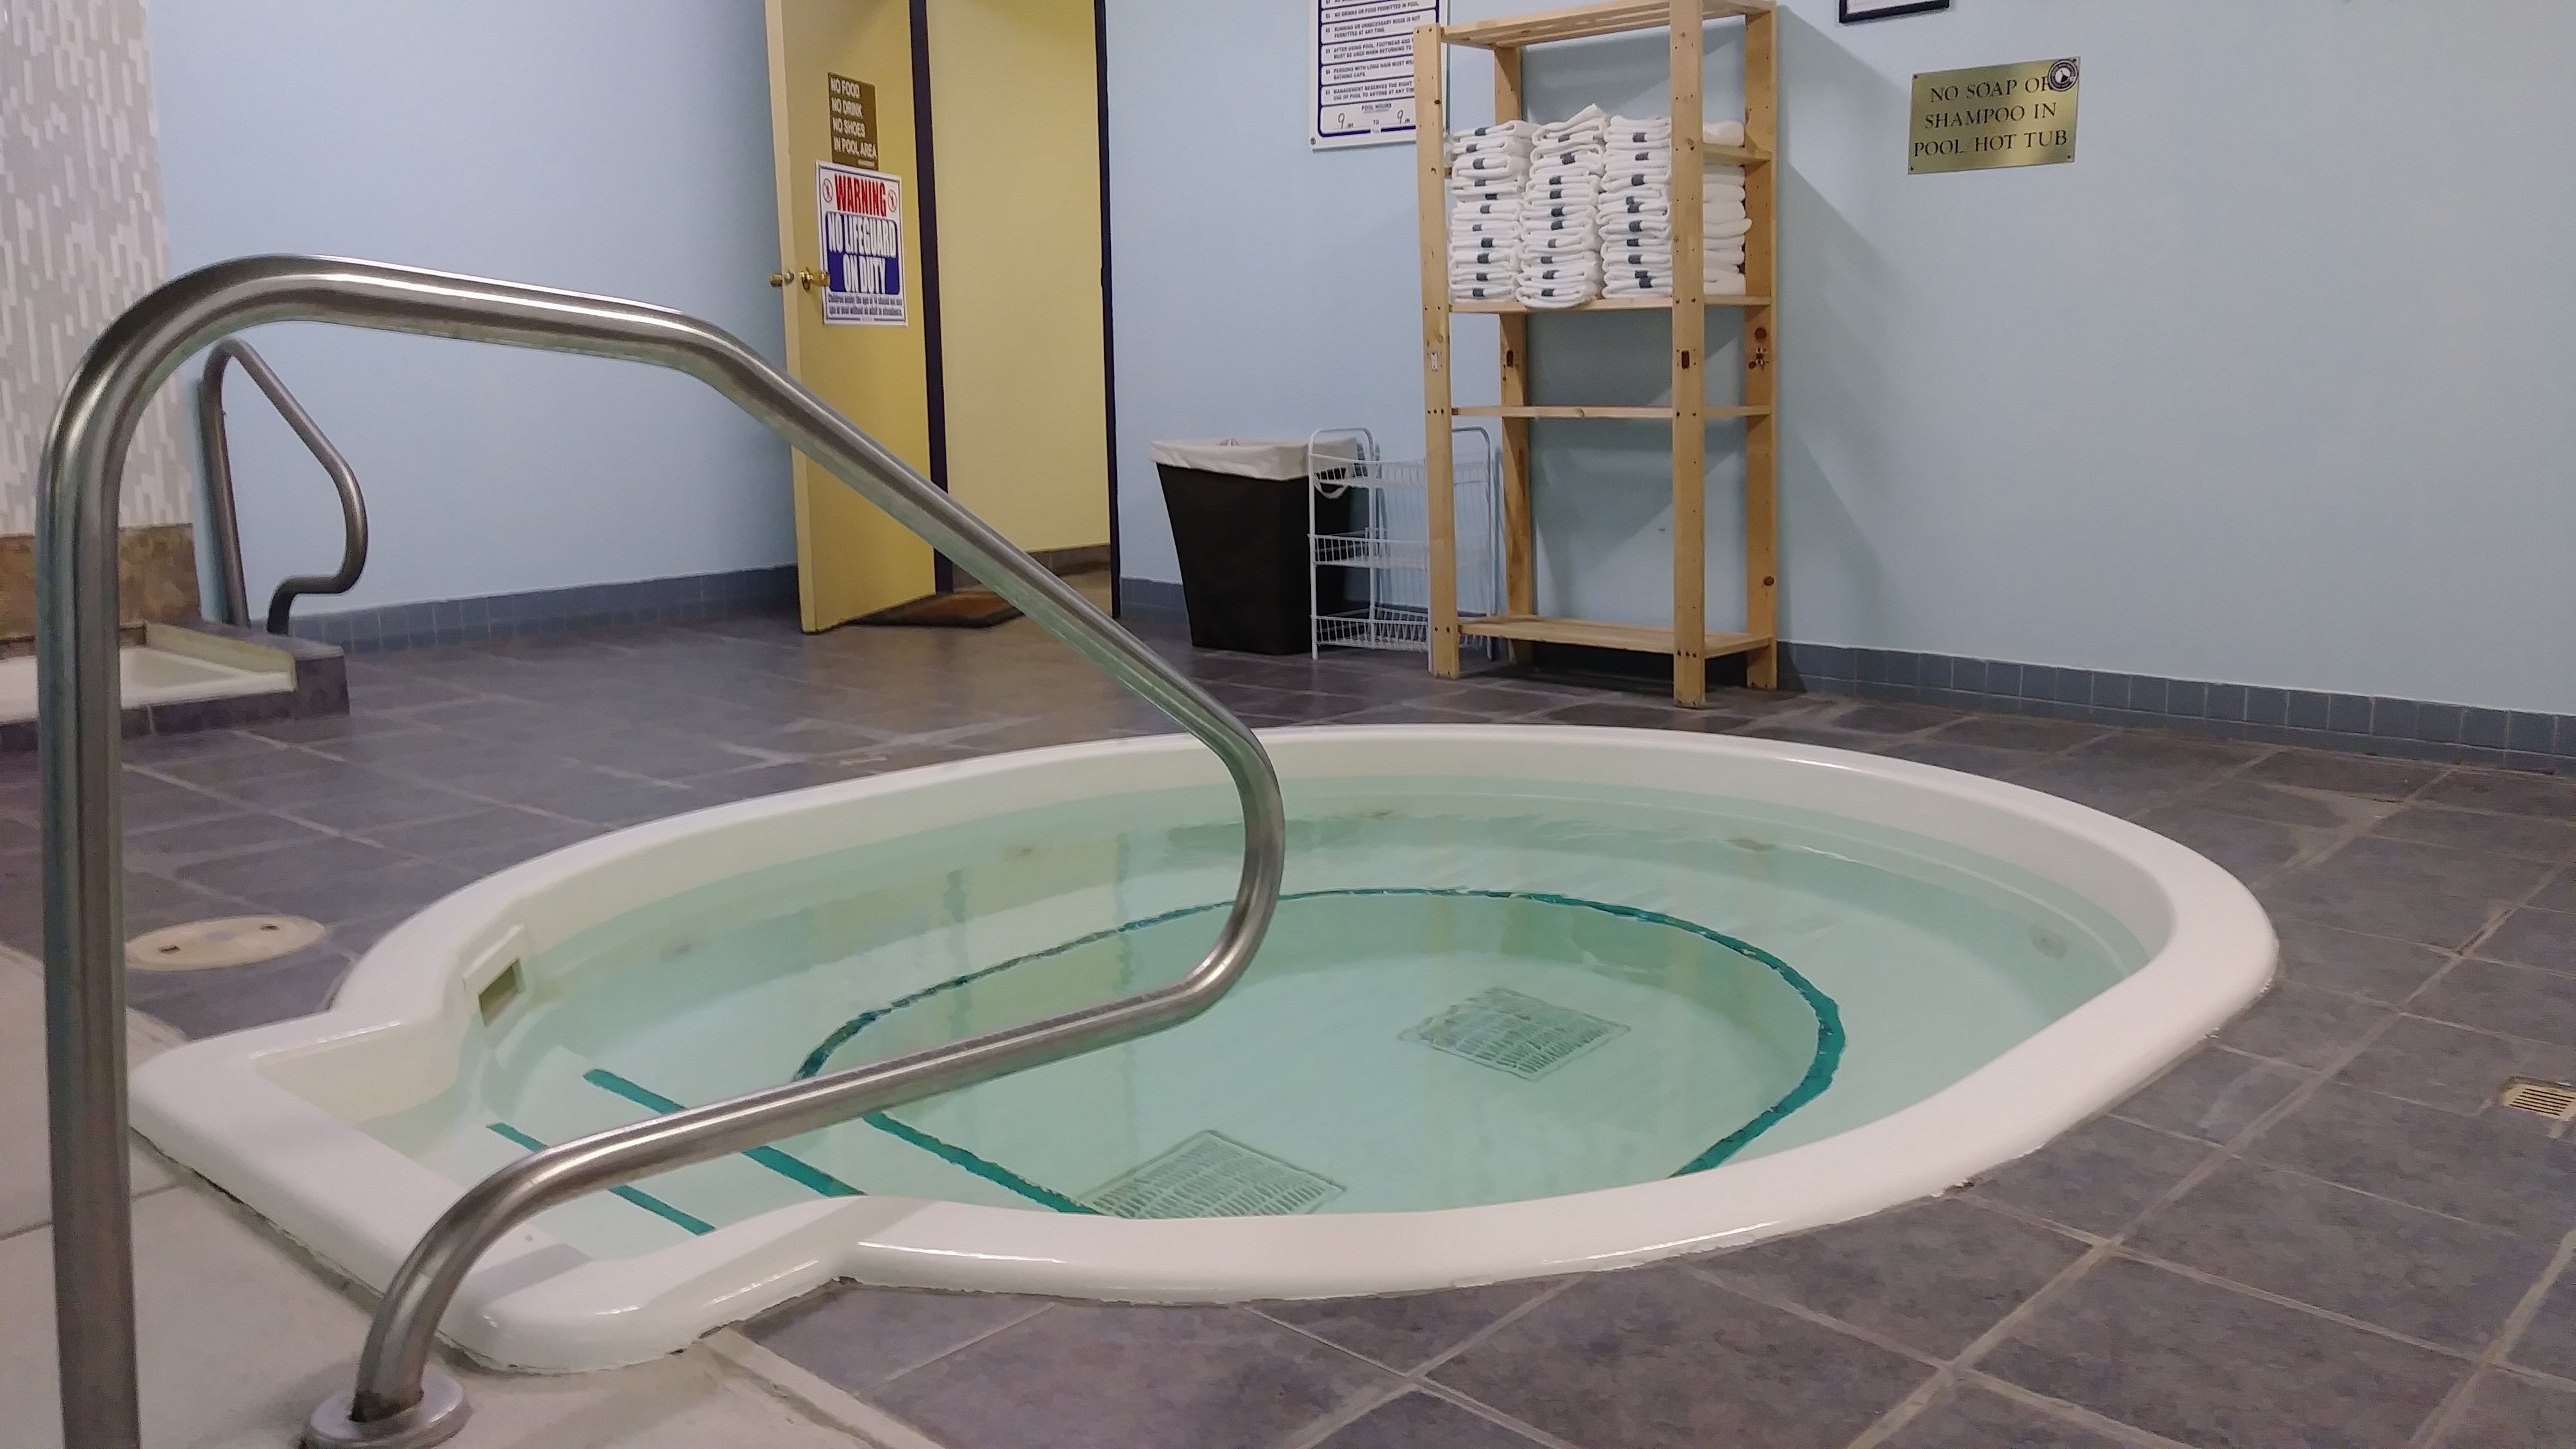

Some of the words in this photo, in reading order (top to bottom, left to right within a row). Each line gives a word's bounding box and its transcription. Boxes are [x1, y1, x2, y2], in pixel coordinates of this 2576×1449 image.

[830, 77, 840, 93] NO
[842, 80, 860, 99] FOOD
[1931, 86, 1958, 102] NO
[1966, 79, 2017, 99] SOAP
[832, 97, 841, 113] NO
[843, 100, 863, 118] DRINK
[1925, 105, 2025, 128] SHAMPOO
[2034, 103, 2056, 118] IN
[833, 117, 843, 133] NO
[844, 119, 865, 138] SHOES
[834, 137, 841, 152] IN
[842, 138, 859, 156] POOL
[861, 142, 877, 159] AREA
[1915, 140, 1964, 156] POOL
[1975, 134, 2017, 152] HOT
[2024, 130, 2067, 148] TUB
[835, 174, 887, 217] WARNING
[827, 213, 843, 253] NO
[844, 214, 896, 258] LIFEGUARD
[843, 254, 858, 292] ON
[859, 256, 885, 294] DUTY
